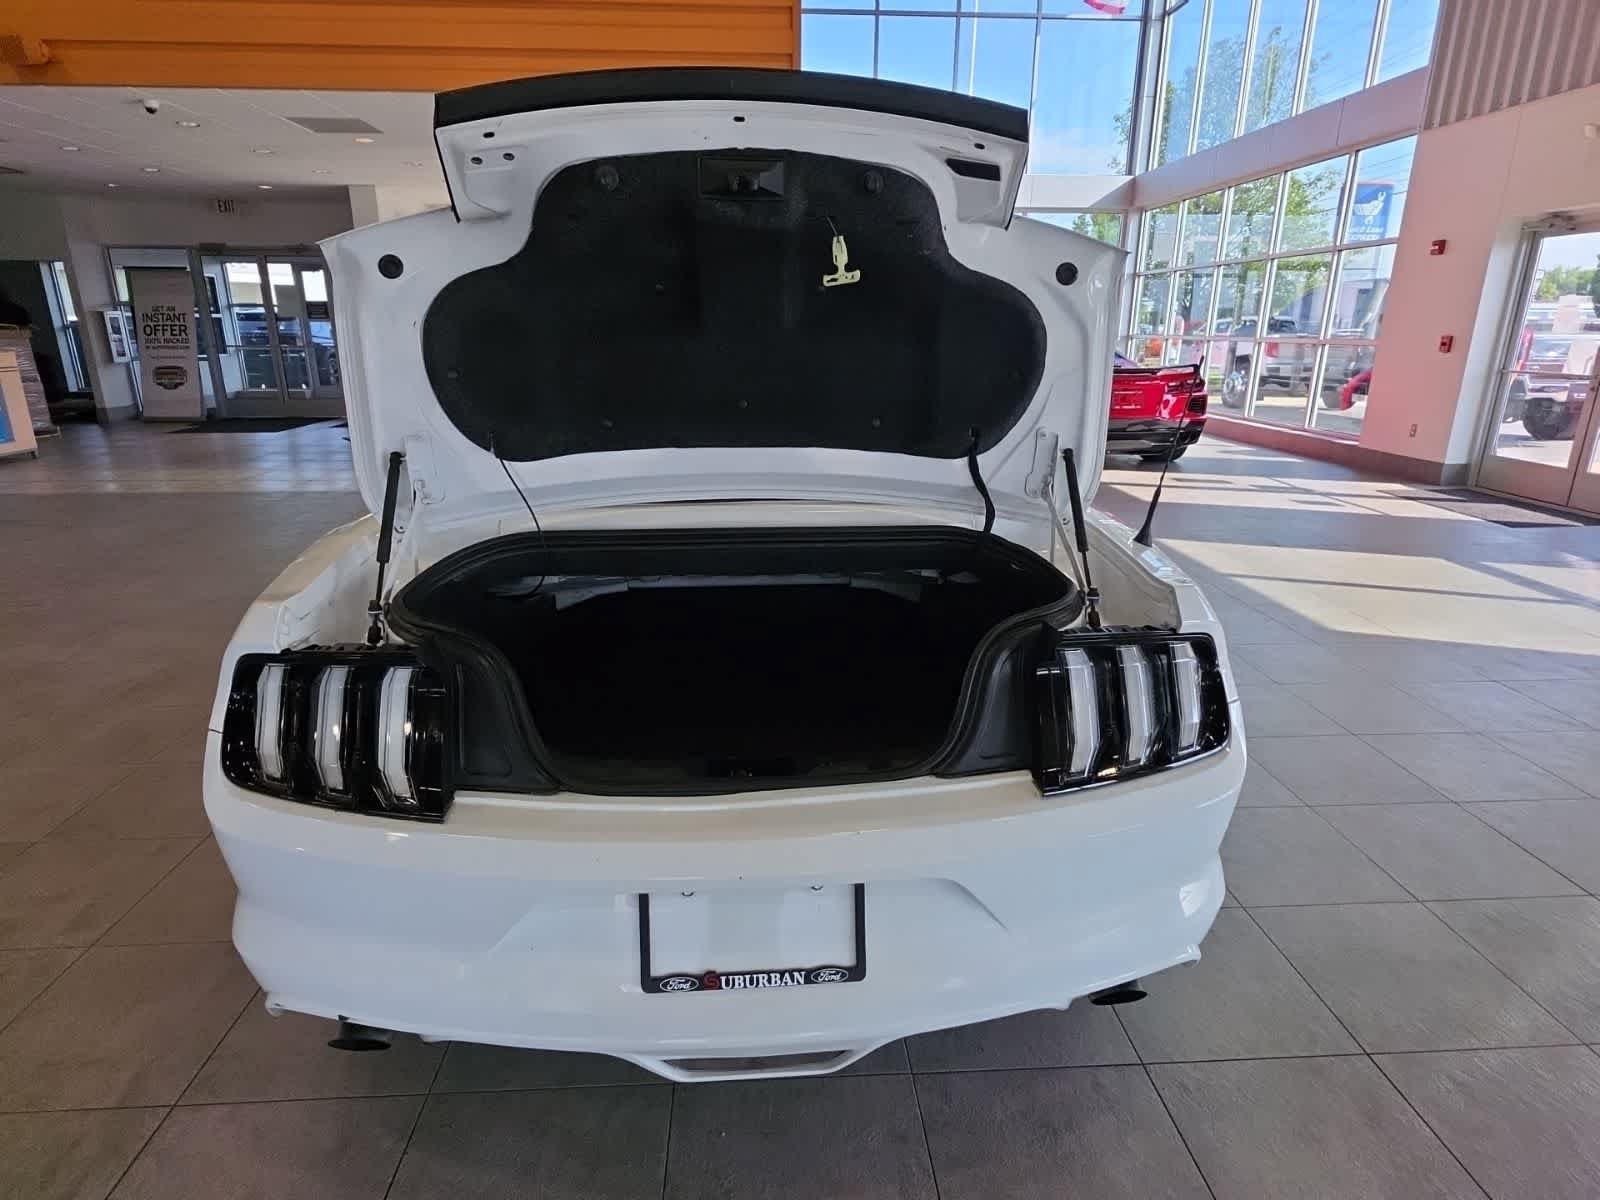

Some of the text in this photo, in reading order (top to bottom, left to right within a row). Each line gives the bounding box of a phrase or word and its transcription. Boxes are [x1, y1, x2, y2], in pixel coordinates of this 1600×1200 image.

[217, 199, 234, 213] EXIT
[142, 312, 188, 323] INSTANT
[143, 324, 188, 337] OFFER
[665, 968, 844, 991] Ford SUBURBAN Ford
